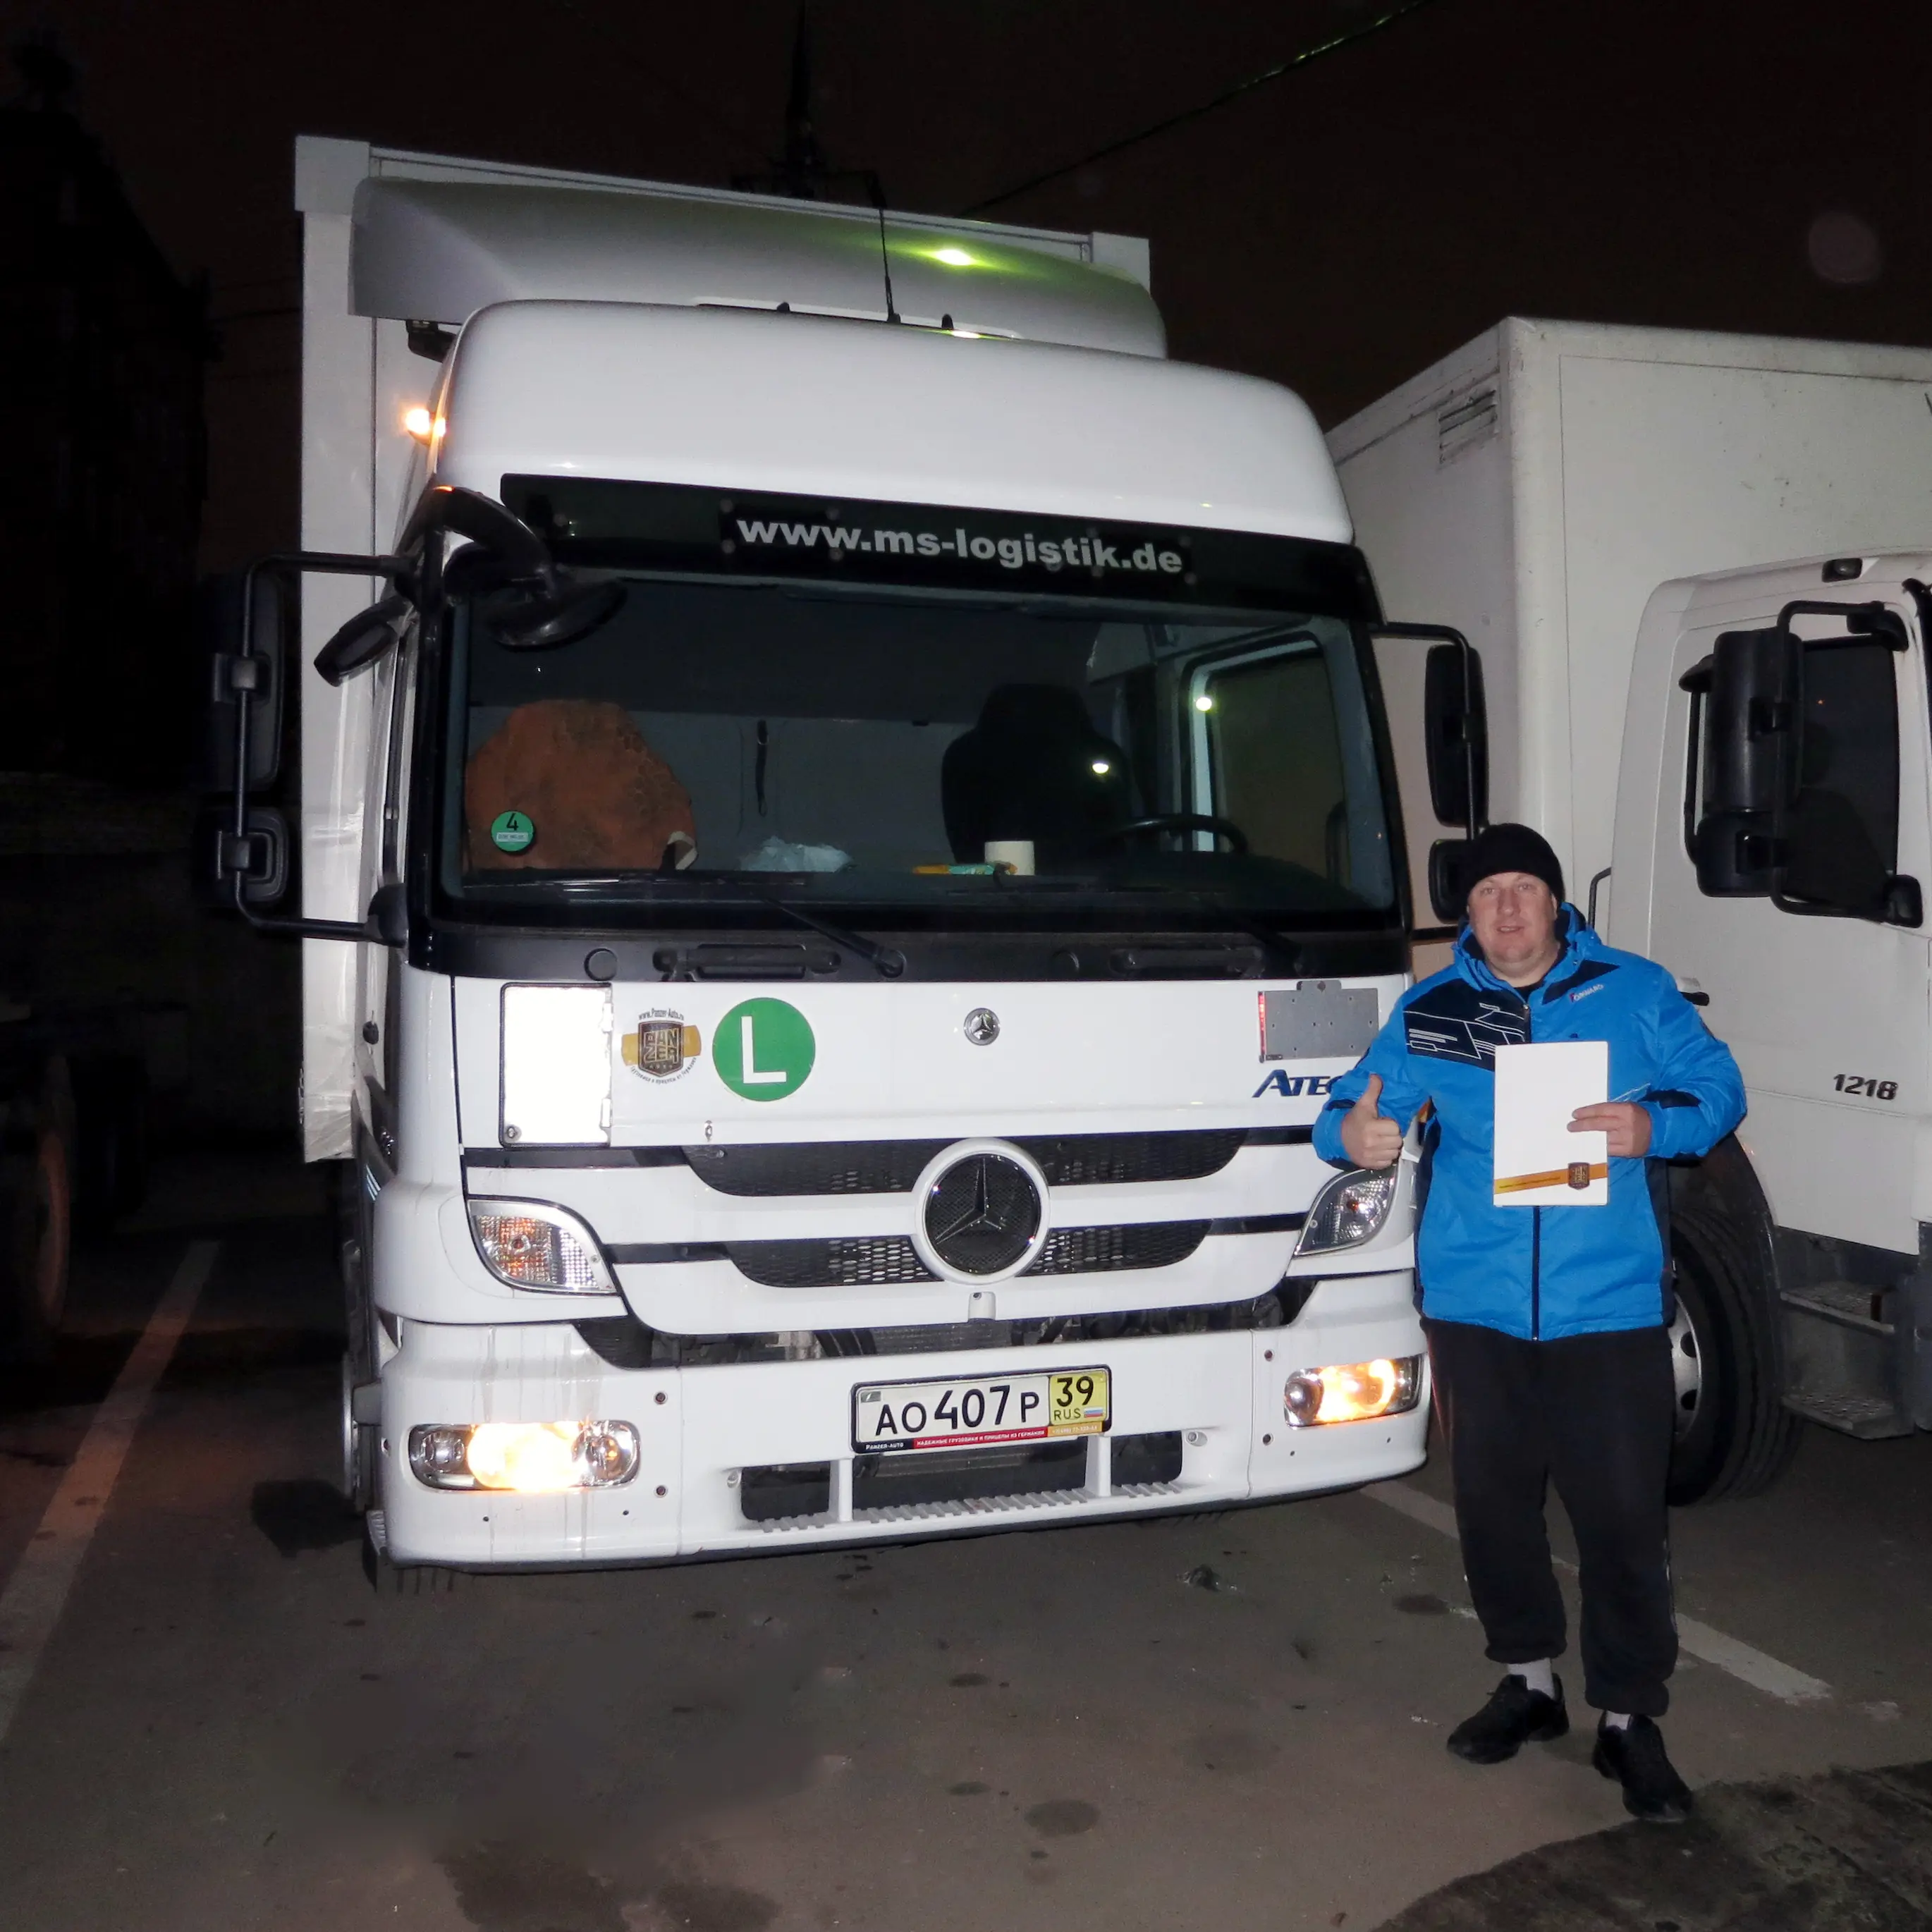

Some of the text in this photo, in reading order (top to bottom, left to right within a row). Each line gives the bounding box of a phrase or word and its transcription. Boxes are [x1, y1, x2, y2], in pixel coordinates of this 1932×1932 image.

[736, 519, 1182, 573] www.ms-logistik.de
[506, 812, 519, 831] 4
[740, 1015, 787, 1084] L
[1833, 1074, 1899, 1101] 1218
[1056, 1376, 1094, 1407] 39
[1053, 1408, 1082, 1421] RUS
